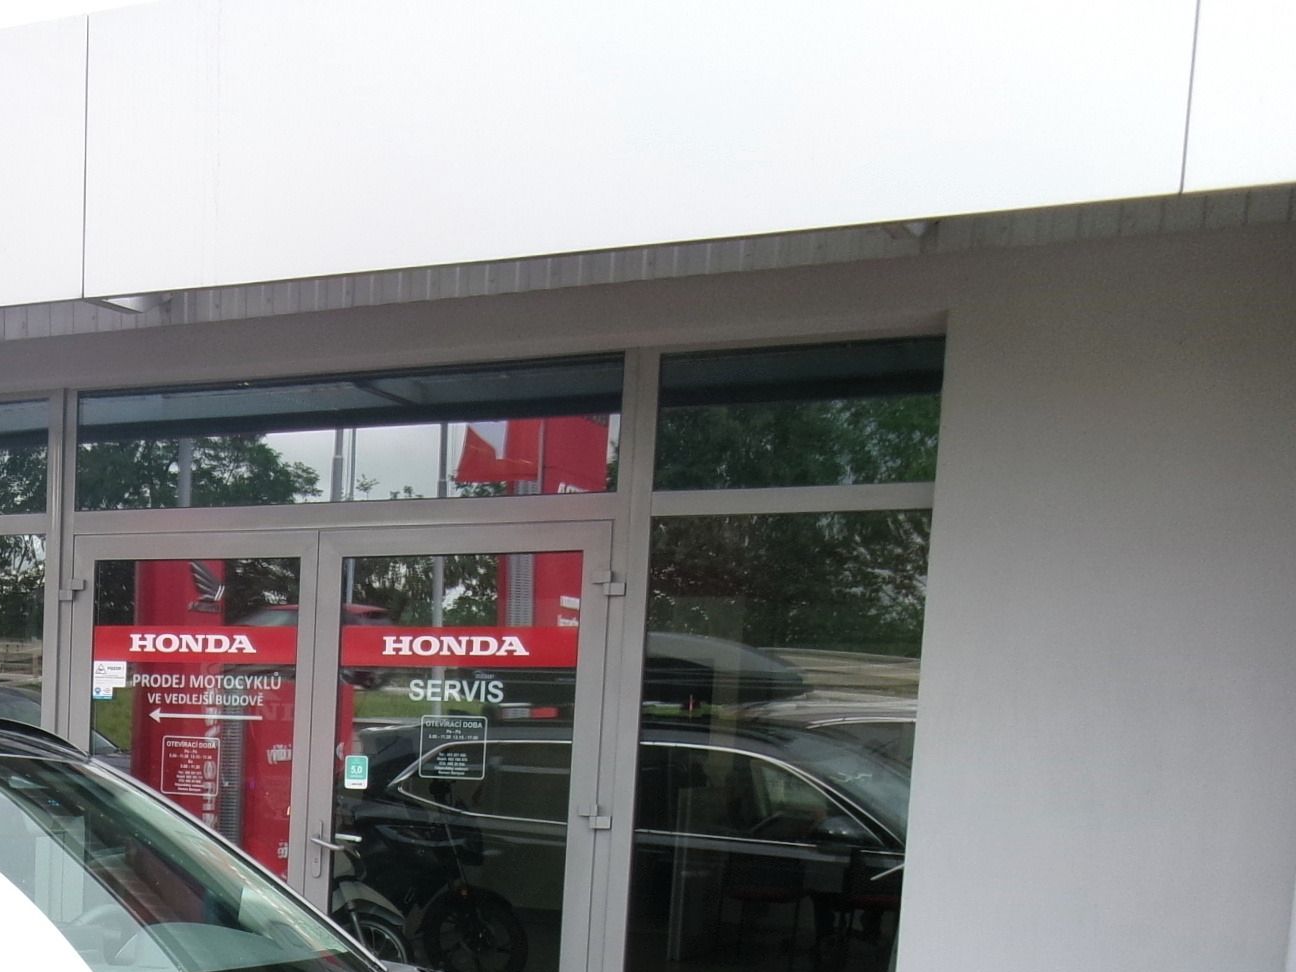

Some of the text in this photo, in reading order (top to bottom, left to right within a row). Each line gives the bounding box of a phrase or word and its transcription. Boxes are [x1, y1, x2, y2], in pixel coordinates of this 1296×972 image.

[129, 633, 257, 654] HONDA
[382, 635, 530, 657] HONDA
[132, 674, 185, 689] PRODEJ
[189, 671, 282, 690] MOTOCYKLŮ
[147, 690, 264, 707] VE VEDLEJŠÍ BUDOVĚ
[408, 679, 504, 704] SERVIS
[463, 721, 483, 729] DOBA
